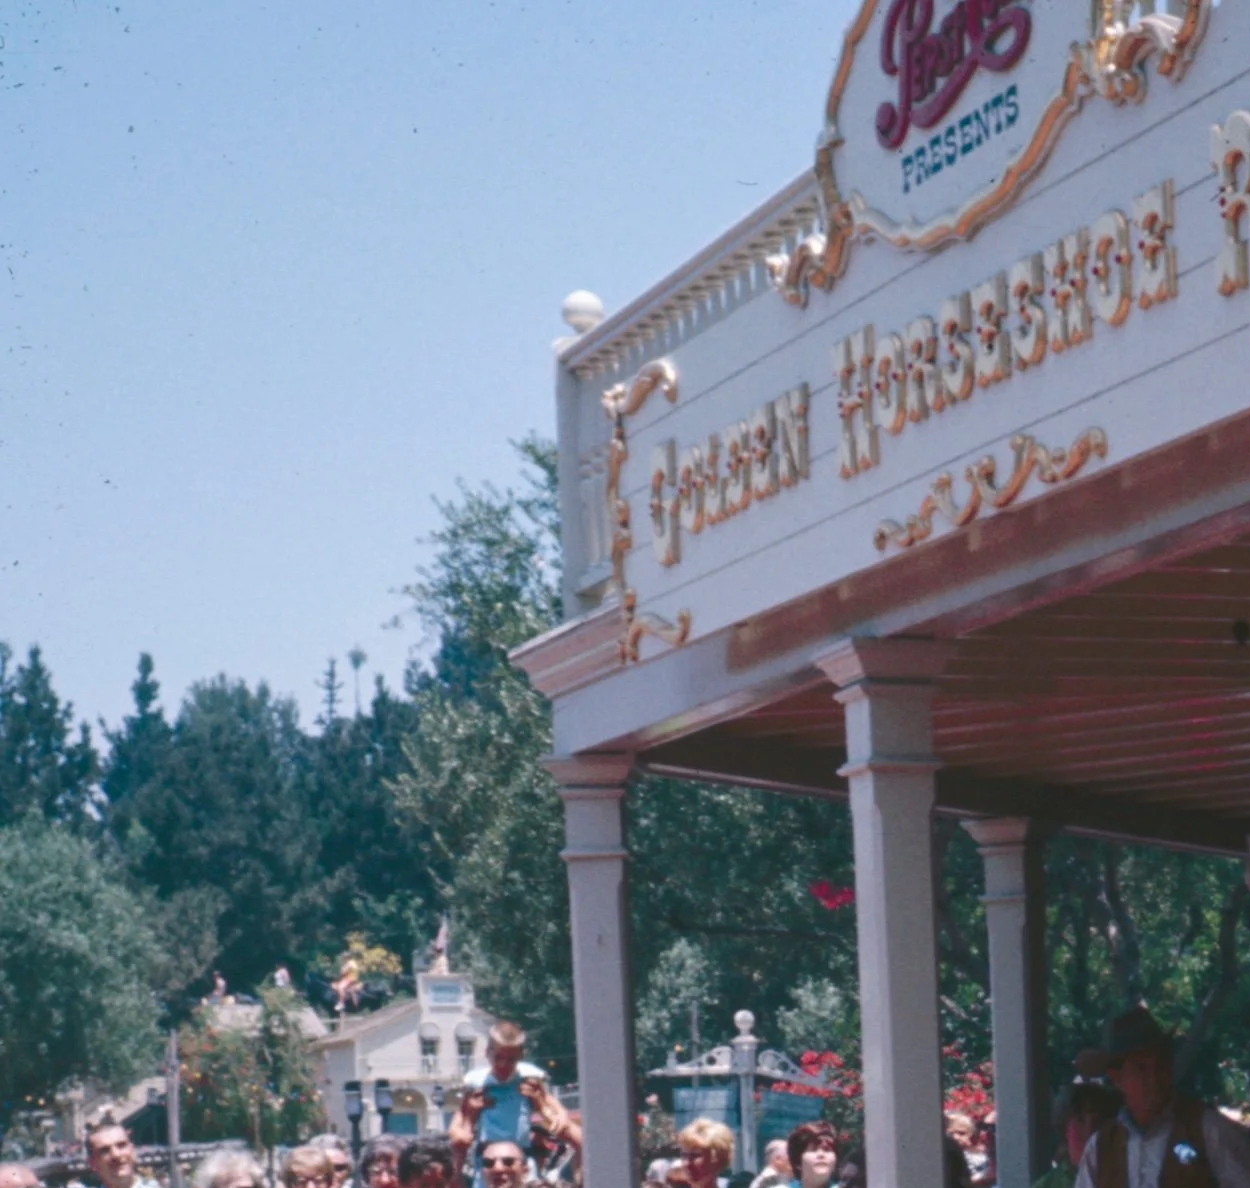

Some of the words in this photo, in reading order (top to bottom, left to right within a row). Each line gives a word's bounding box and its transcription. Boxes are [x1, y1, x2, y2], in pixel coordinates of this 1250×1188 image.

[901, 84, 1020, 194] PRESENTS
[650, 381, 810, 568] GOLDEN
[833, 178, 1179, 481] HORSESHOE
